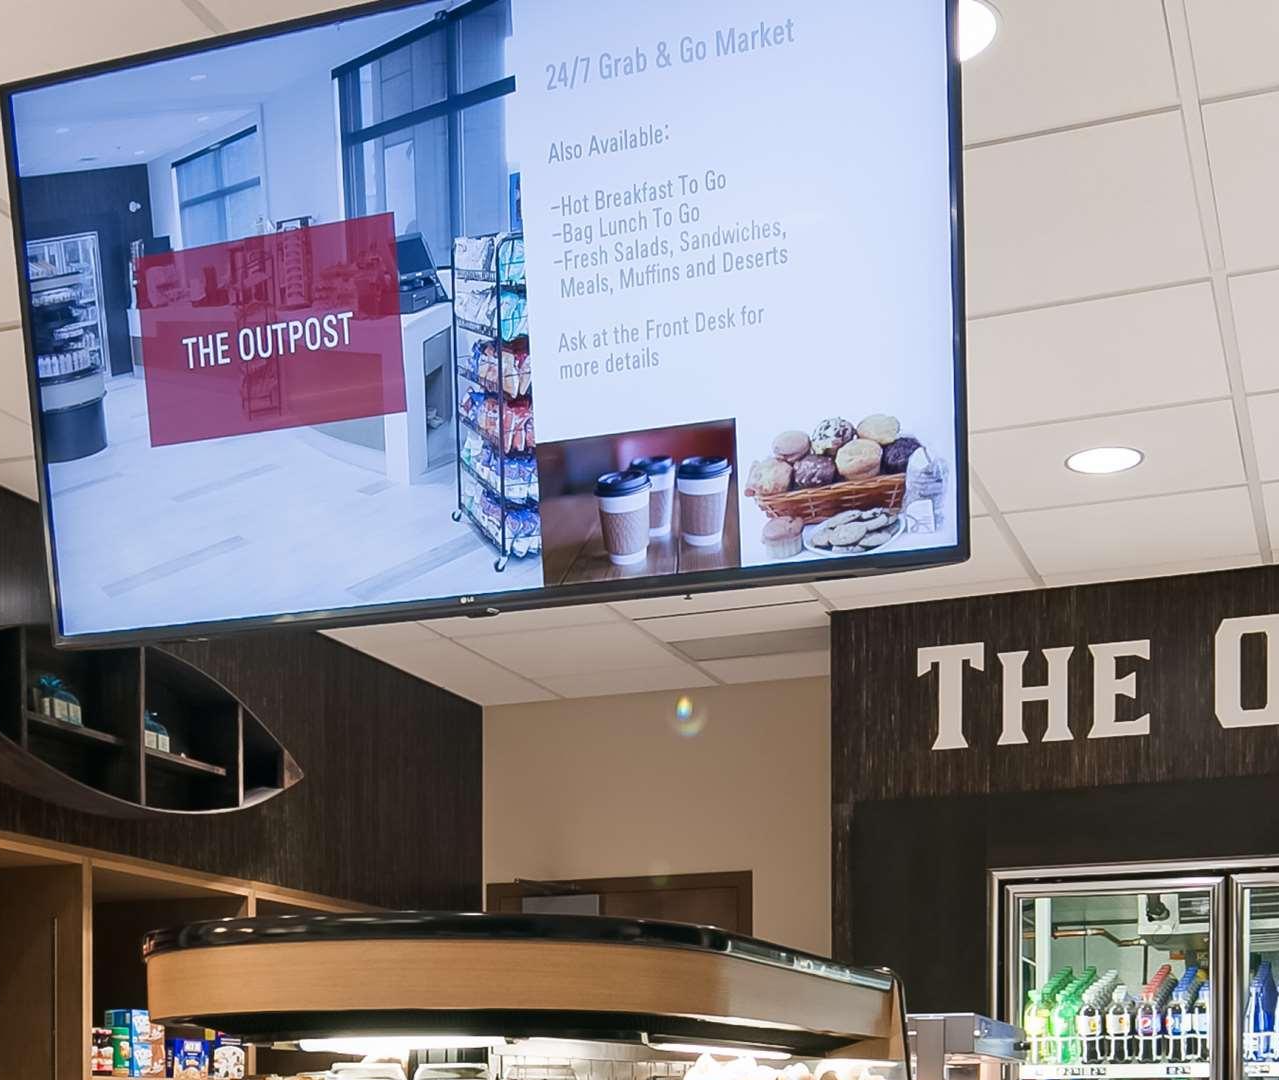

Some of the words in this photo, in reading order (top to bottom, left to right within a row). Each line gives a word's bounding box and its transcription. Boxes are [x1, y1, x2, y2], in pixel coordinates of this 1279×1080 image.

[545, 56, 591, 91] 24/7
[599, 46, 647, 80] Grab
[655, 40, 672, 68] &
[680, 36, 707, 63] Go
[715, 18, 795, 56] Market
[548, 138, 583, 164] Also
[588, 124, 670, 157] Available:
[594, 179, 673, 210] Breakfast
[678, 174, 698, 196] To
[705, 170, 727, 191] Go
[599, 207, 648, 238] Lunch
[653, 206, 673, 228] To
[679, 202, 700, 223] Go
[614, 233, 675, 263] Salads,
[680, 218, 787, 253] Sandwiches,
[560, 273, 614, 299] Meals,
[619, 259, 680, 288] Muffins
[686, 254, 716, 279] and
[722, 246, 788, 274] Deserts
[182, 332, 231, 370] THE
[238, 311, 354, 362] OUTPOST
[558, 329, 587, 353] Ask
[592, 328, 608, 349] at
[613, 320, 639, 346] the
[645, 314, 689, 341] Front
[695, 306, 736, 334] Desk
[740, 304, 765, 326] for
[560, 358, 599, 380] more
[605, 348, 660, 375] details
[917, 640, 1150, 751] THE
